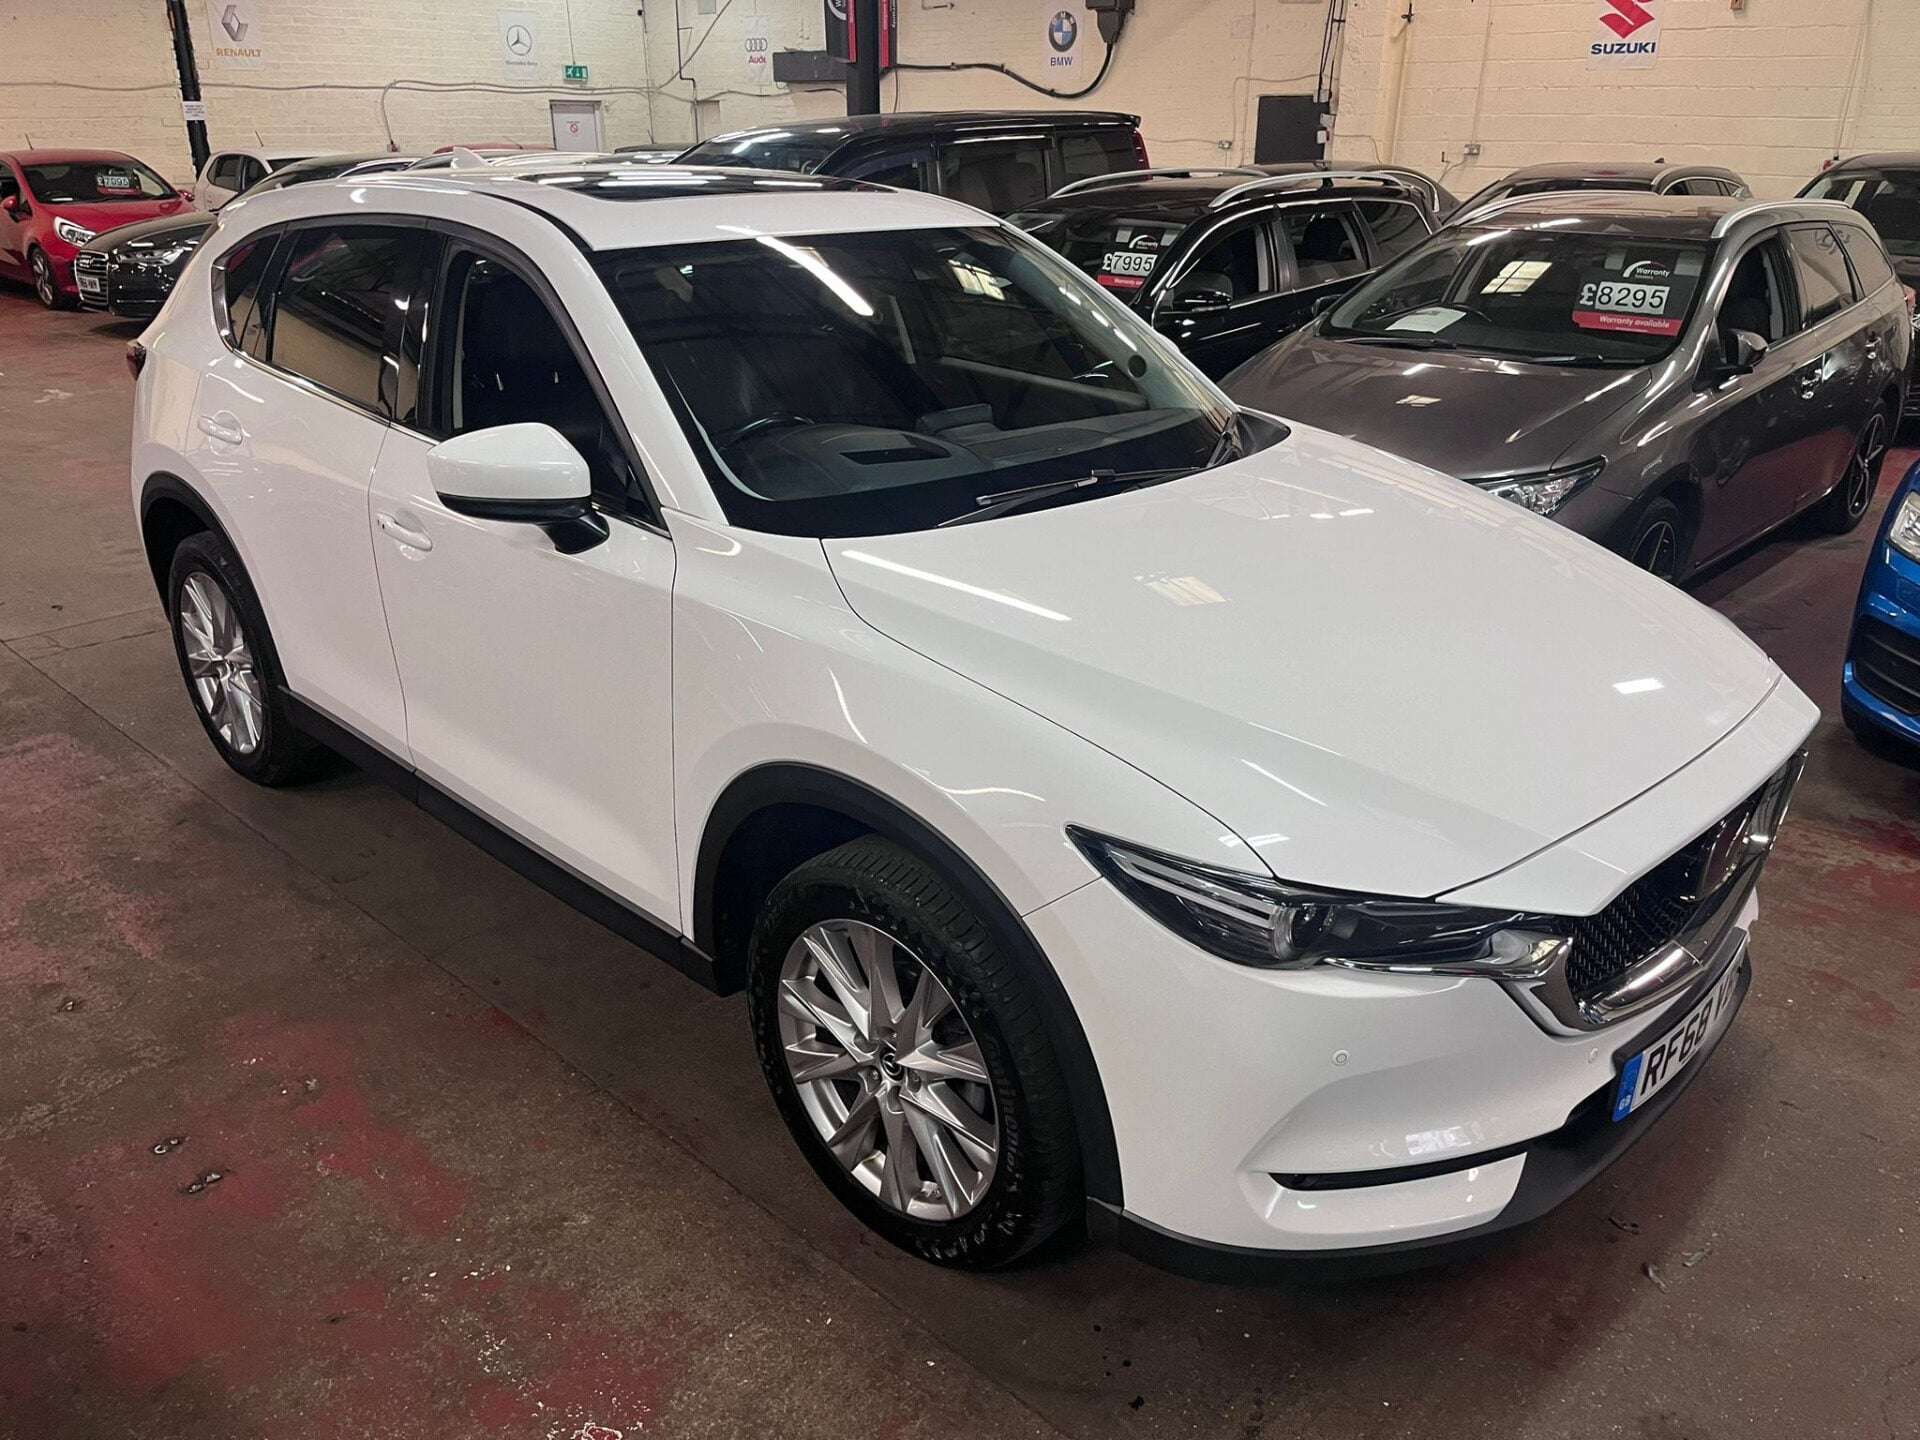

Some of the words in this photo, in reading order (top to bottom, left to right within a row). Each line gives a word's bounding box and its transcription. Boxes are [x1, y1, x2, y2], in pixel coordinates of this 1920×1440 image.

[216, 47, 262, 57] RENAULT
[1591, 42, 1656, 55] SUZUKI
[1050, 56, 1073, 66] BMW
[1102, 253, 1155, 272] £7995
[1636, 267, 1670, 278] Warranty
[1579, 283, 1666, 309] £8295
[1600, 314, 1634, 327] Warranty
[1640, 996, 1714, 1096] RF68
